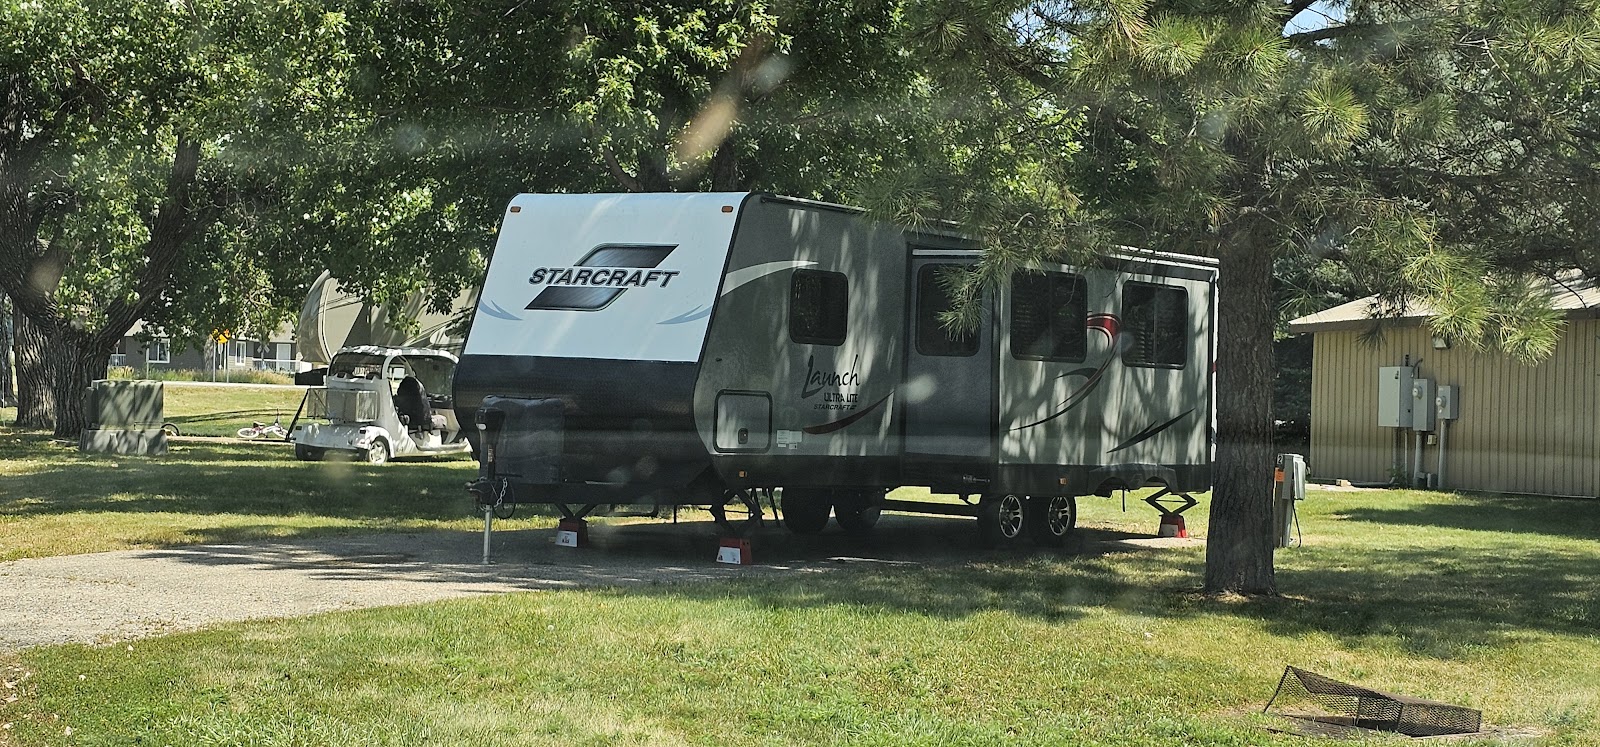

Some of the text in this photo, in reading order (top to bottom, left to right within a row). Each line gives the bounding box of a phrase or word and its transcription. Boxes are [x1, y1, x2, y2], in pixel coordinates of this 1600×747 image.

[528, 267, 681, 288] STARCRAFT
[801, 354, 860, 399] Launch
[823, 393, 858, 402] ULTRA LITE
